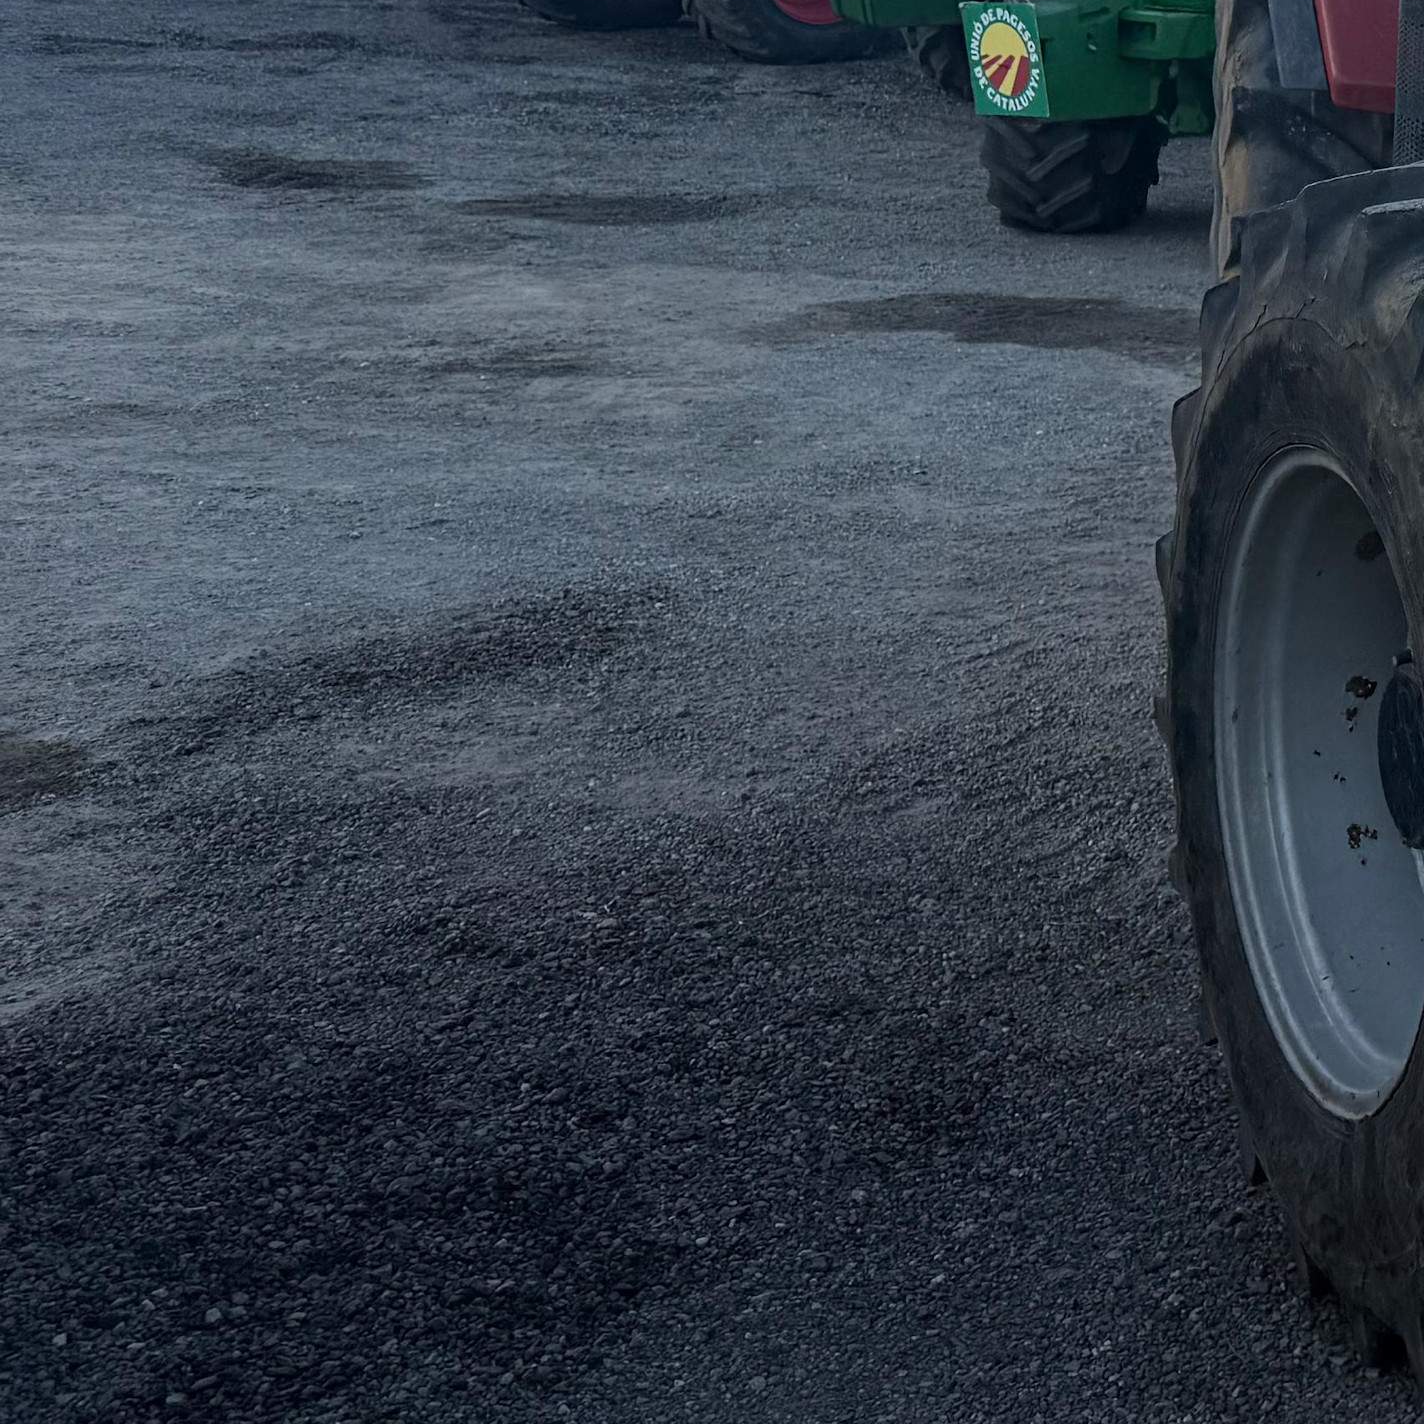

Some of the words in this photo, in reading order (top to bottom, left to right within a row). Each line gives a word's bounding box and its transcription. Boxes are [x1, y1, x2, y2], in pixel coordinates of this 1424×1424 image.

[970, 20, 983, 61] UNIÓ
[980, 9, 996, 25] DE
[996, 7, 1039, 62] PAGESOS
[973, 66, 989, 89] DE
[986, 68, 1040, 112] CATALUNYA
